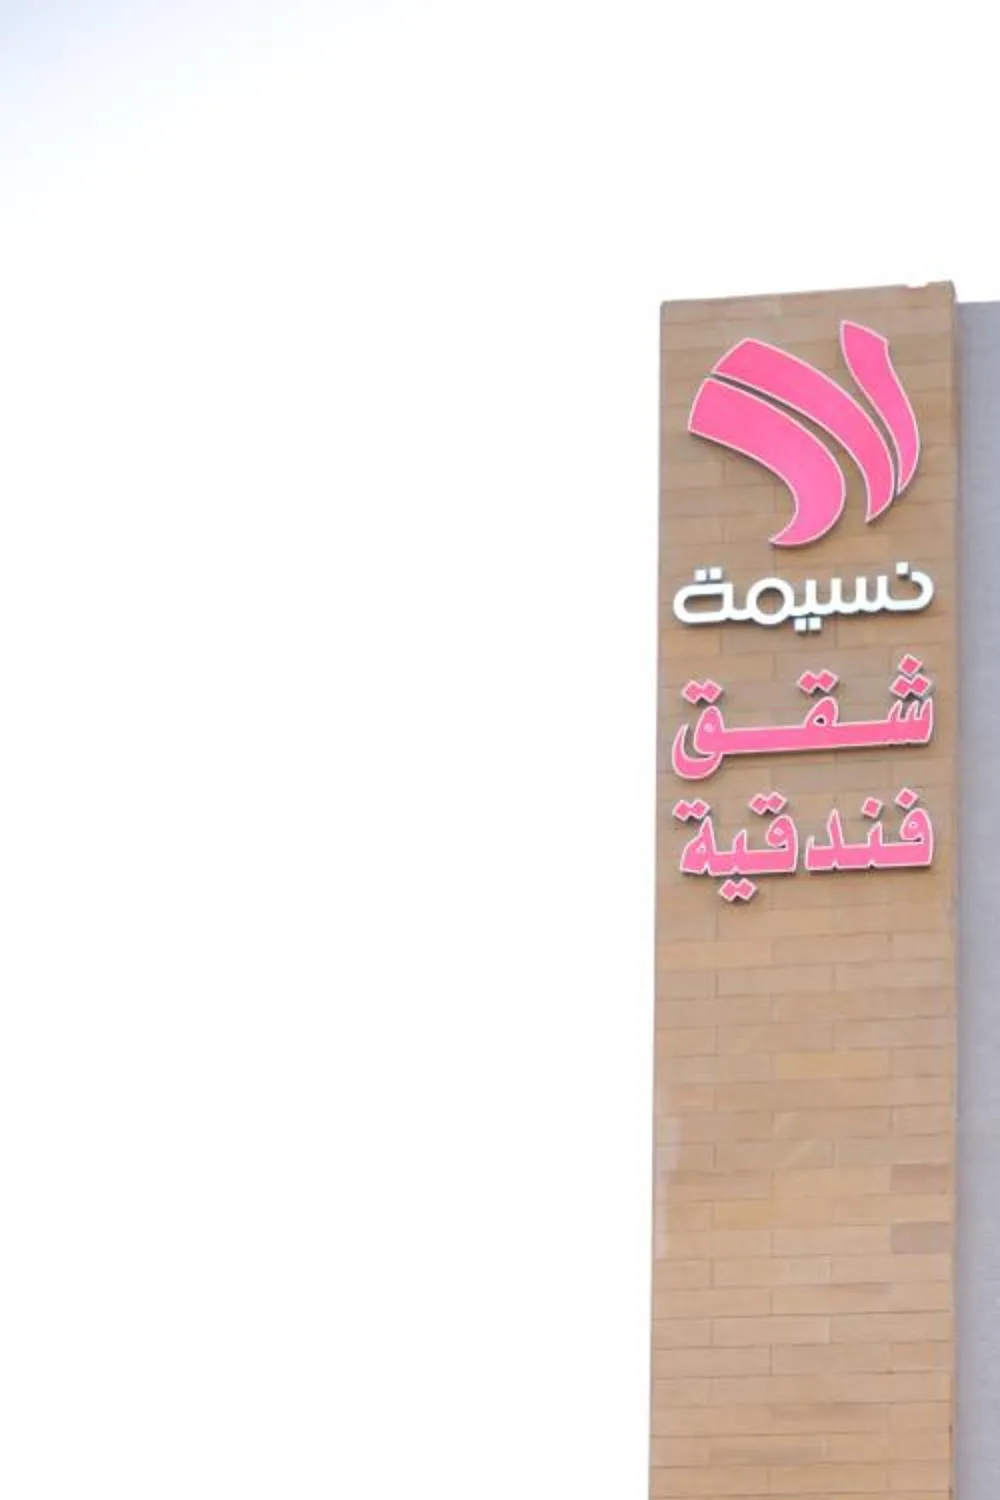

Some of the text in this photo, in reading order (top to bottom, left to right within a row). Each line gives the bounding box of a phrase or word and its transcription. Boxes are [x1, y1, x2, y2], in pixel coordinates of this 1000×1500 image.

[673, 561, 934, 632] نسيمة
[672, 653, 934, 780] شقق
[672, 787, 934, 901] فندقية
